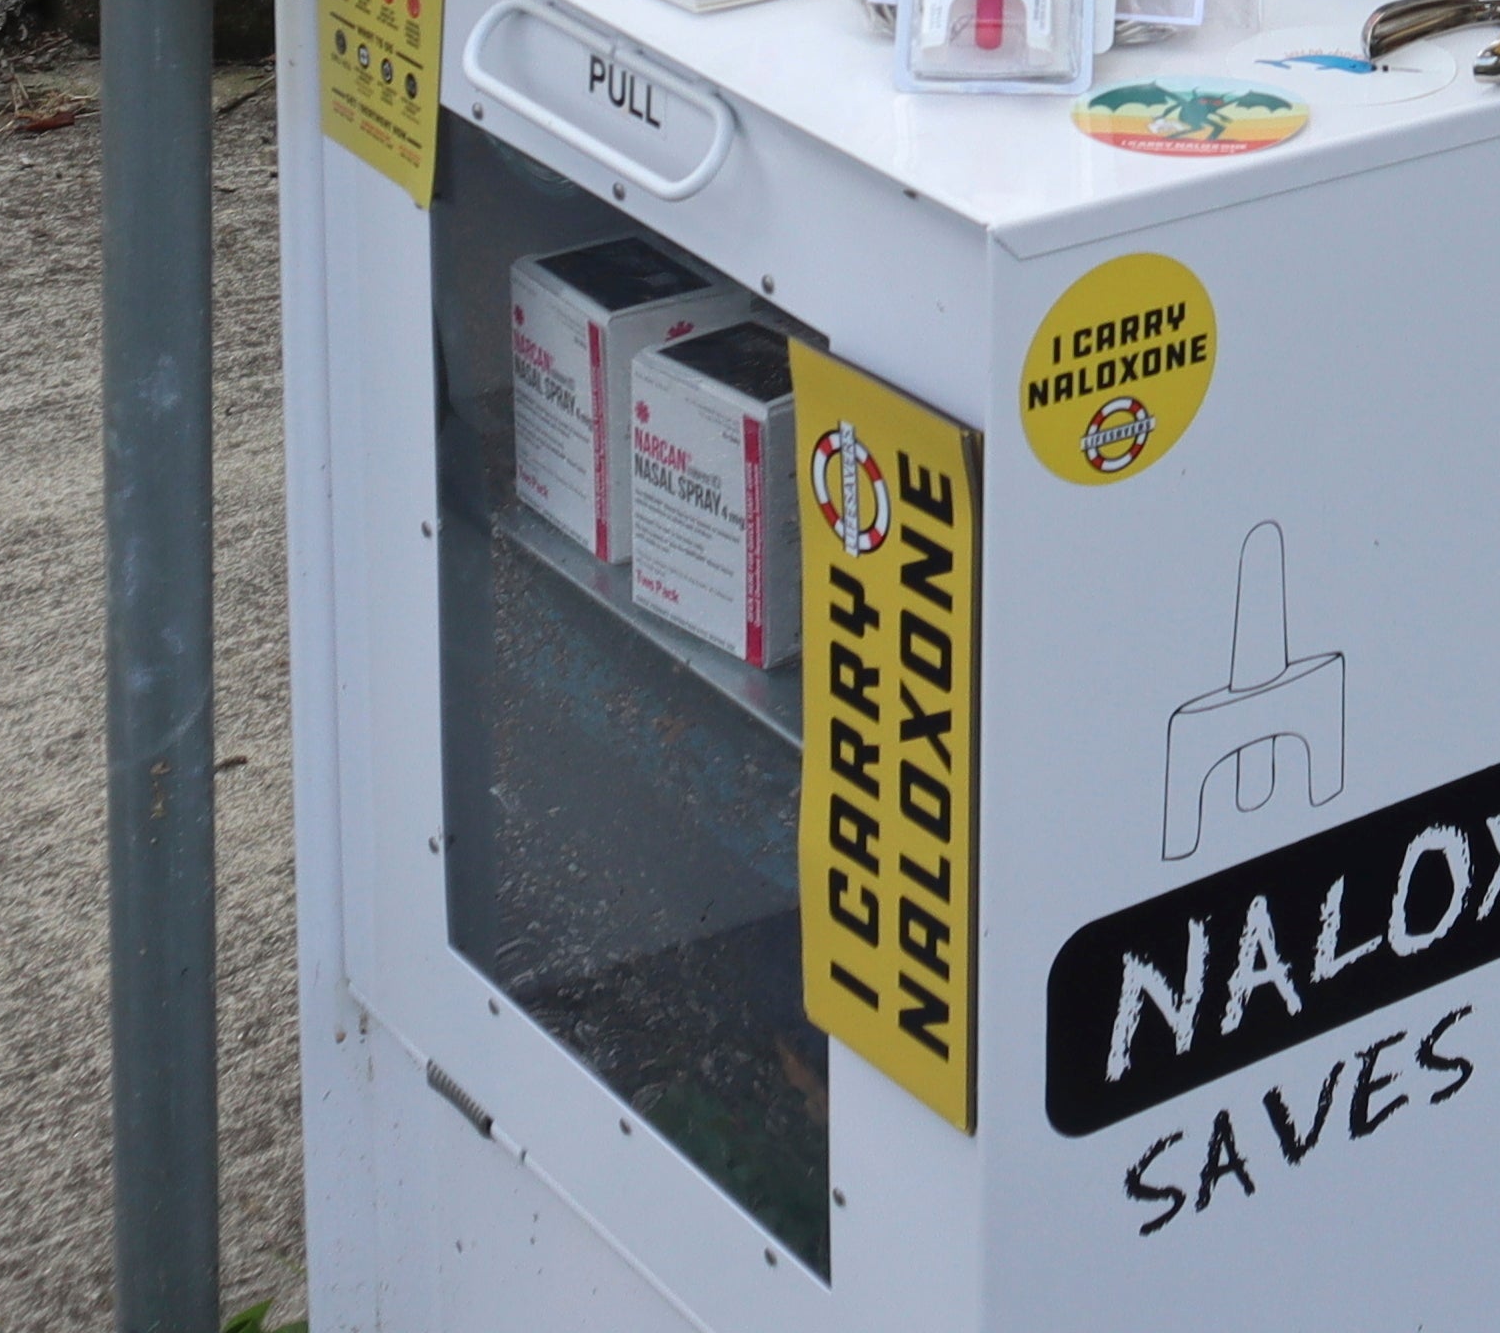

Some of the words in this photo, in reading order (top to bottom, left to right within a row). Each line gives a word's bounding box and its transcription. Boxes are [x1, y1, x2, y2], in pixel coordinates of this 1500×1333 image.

[589, 55, 661, 129] PULL
[1053, 336, 1061, 364] I
[1073, 301, 1186, 359] CARRY
[1028, 333, 1207, 411] NALOXONE
[635, 452, 675, 496] NASAL
[678, 476, 722, 517] SPRAY
[722, 506, 728, 520] 4
[728, 512, 746, 533] mg
[636, 570, 654, 591] Two
[656, 581, 680, 605] Pack
[828, 564, 881, 950] CARRY
[897, 449, 954, 1061] NALOXONE
[830, 959, 881, 1012] I
[1125, 1003, 1474, 1235] SAVES
